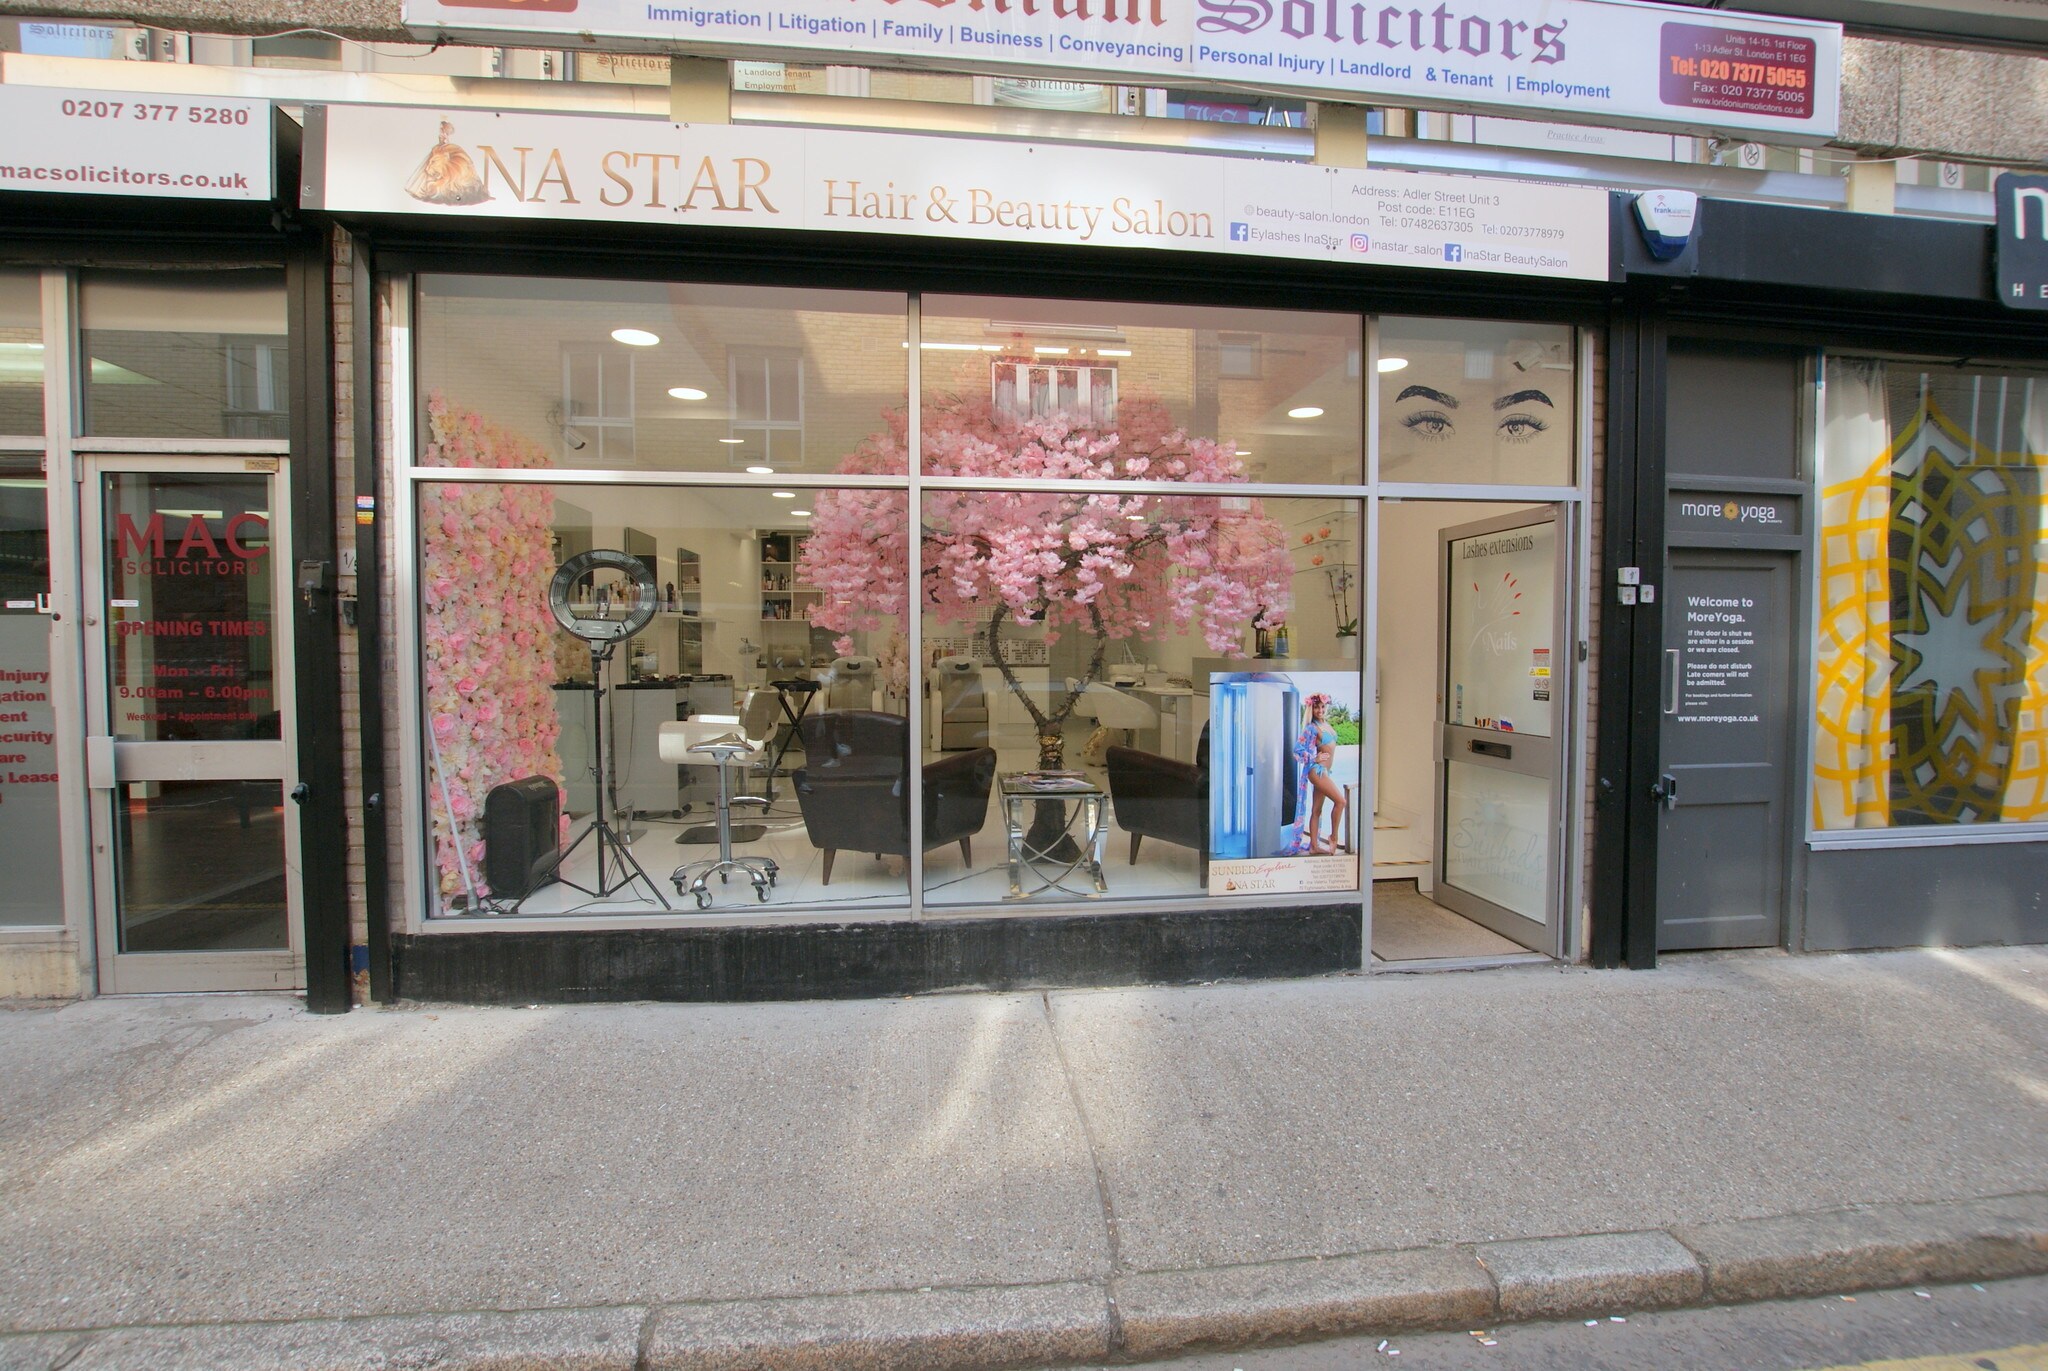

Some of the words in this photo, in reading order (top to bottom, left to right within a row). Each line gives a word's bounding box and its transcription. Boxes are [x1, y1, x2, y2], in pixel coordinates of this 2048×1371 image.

[29, 24, 115, 39] Solicitors
[1196, 0, 1568, 65] Solicitors
[647, 4, 761, 26] Immigration
[779, 13, 866, 35] Litigation
[883, 20, 944, 43] Family
[961, 27, 1043, 48] Business
[1059, 35, 1183, 62] Conveyancing
[1200, 46, 1273, 67] Personal
[1278, 53, 1325, 75] Injury
[1340, 59, 1411, 79] Landlord
[1426, 67, 1437, 82] &
[1441, 69, 1494, 88] Tenant
[1516, 76, 1610, 98] Employment
[1725, 34, 1746, 45] Units
[1774, 39, 1786, 49] 1st
[1787, 41, 1807, 51] Floor
[1694, 43, 1711, 53] 1-13
[1713, 45, 1732, 55] Adler
[1746, 49, 1775, 60] London
[1776, 52, 1787, 61] E1
[1789, 53, 1806, 63] 1EG
[744, 68, 781, 77] Landlord
[784, 70, 812, 78] Tenant
[1670, 55, 1697, 77] Tel:
[1700, 59, 1730, 80] 020
[1732, 62, 1765, 84] 7377
[1766, 66, 1806, 88] 5055
[744, 81, 796, 91] Employment
[1693, 81, 1718, 94] Fax:
[1721, 84, 1742, 96] 020
[1746, 87, 1773, 100] 7377
[1776, 90, 1805, 103] 5005
[62, 99, 124, 119] 0207
[133, 103, 179, 121] 377
[188, 106, 249, 125] 5280
[1692, 95, 1804, 115] www.londoniumsolicitors.co.uk
[1547, 129, 1579, 142] Practice
[600, 150, 780, 214] STAR
[1351, 184, 1399, 198] Address:
[1403, 188, 1431, 201] Adler
[1434, 190, 1466, 204] Street
[1469, 194, 1490, 206] Unit
[1493, 195, 1500, 206] 3
[823, 179, 918, 221] Hair
[925, 185, 959, 224] &
[968, 188, 1104, 241] Beauty
[1111, 197, 1214, 239] Salon
[1256, 205, 1370, 226] beauty-salon.london
[1377, 201, 1402, 214] Post
[1405, 204, 1435, 216] code:
[1439, 206, 1475, 219] E11EG
[1251, 227, 1301, 243] Eylashes
[1304, 233, 1344, 247] InaStar
[1379, 215, 1398, 228] Tel:
[1401, 218, 1474, 234] 07482637305
[1482, 223, 1498, 235] Tel:
[1500, 225, 1565, 240] 02073778979
[1371, 239, 1443, 256] inastar_salon
[1464, 248, 1501, 262] InaStar
[1504, 252, 1568, 268] BeautySalon
[1681, 503, 1721, 517] more
[1740, 505, 1775, 523] yoga
[116, 513, 269, 559] MAC
[1462, 539, 1488, 560] Lashes
[1489, 532, 1533, 556] extensions
[126, 561, 260, 575] SOLICITORS
[1687, 596, 1739, 607] Welcome
[1741, 598, 1753, 607] to
[1687, 612, 1746, 624] MoreYoga.
[116, 620, 203, 637] OPENING
[208, 621, 266, 637] TIMES
[1481, 631, 1517, 656] Nails
[0, 669, 50, 683] Injury
[152, 664, 189, 677] Mon
[210, 664, 235, 677] Fri
[119, 686, 184, 699] 9.00am
[204, 685, 269, 700] 6.00pm
[126, 712, 167, 721] Weekend
[178, 712, 237, 722] Appointment
[239, 712, 257, 722] only
[1677, 714, 1759, 723] www.moreyoga.co.uk
[1211, 864, 1257, 876] SUNBED
[1250, 879, 1276, 889] STAR
